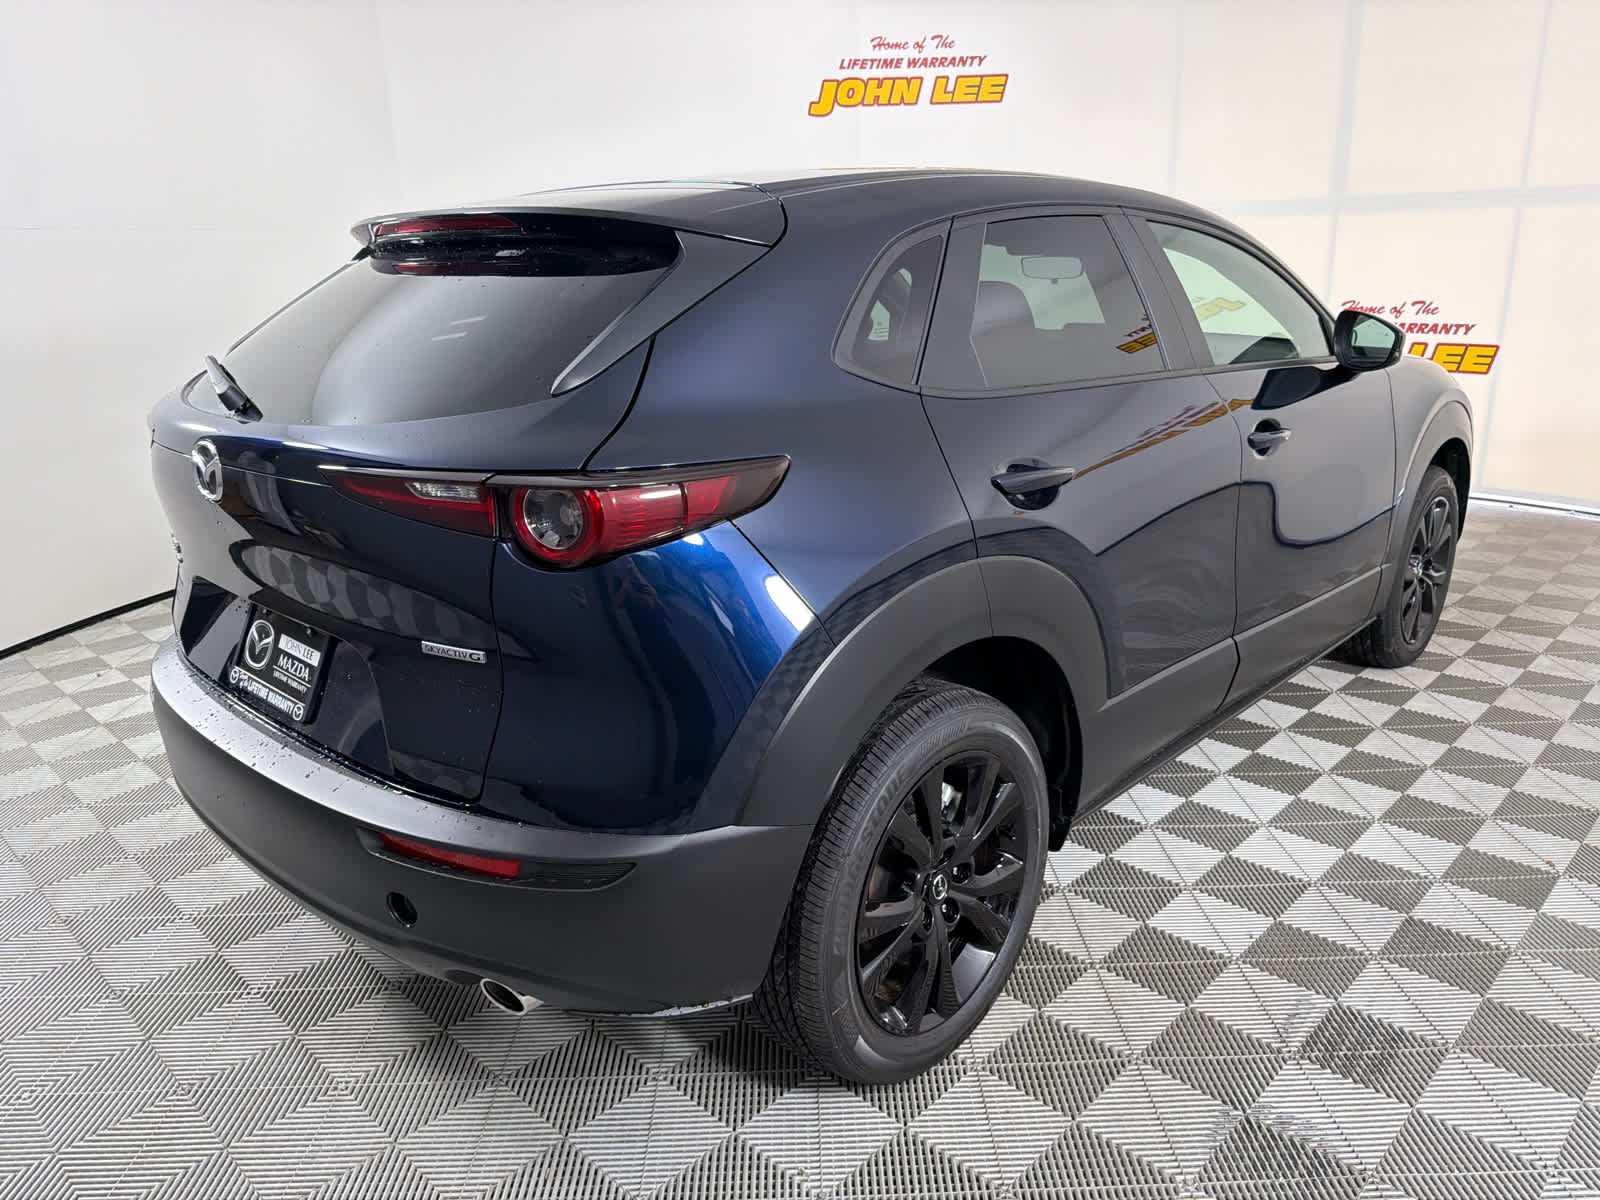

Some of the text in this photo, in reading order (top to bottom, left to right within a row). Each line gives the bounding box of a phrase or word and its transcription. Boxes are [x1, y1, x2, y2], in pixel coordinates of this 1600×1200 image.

[870, 34, 955, 53] Home of The
[839, 55, 987, 70] LIFETIME WARRANTY
[808, 74, 1009, 117] JOHN LEE
[1389, 301, 1406, 318] of
[1411, 300, 1440, 316] The
[1394, 322, 1476, 335] ARRANTY
[303, 646, 315, 661] LEE
[277, 653, 310, 681] MAZDA
